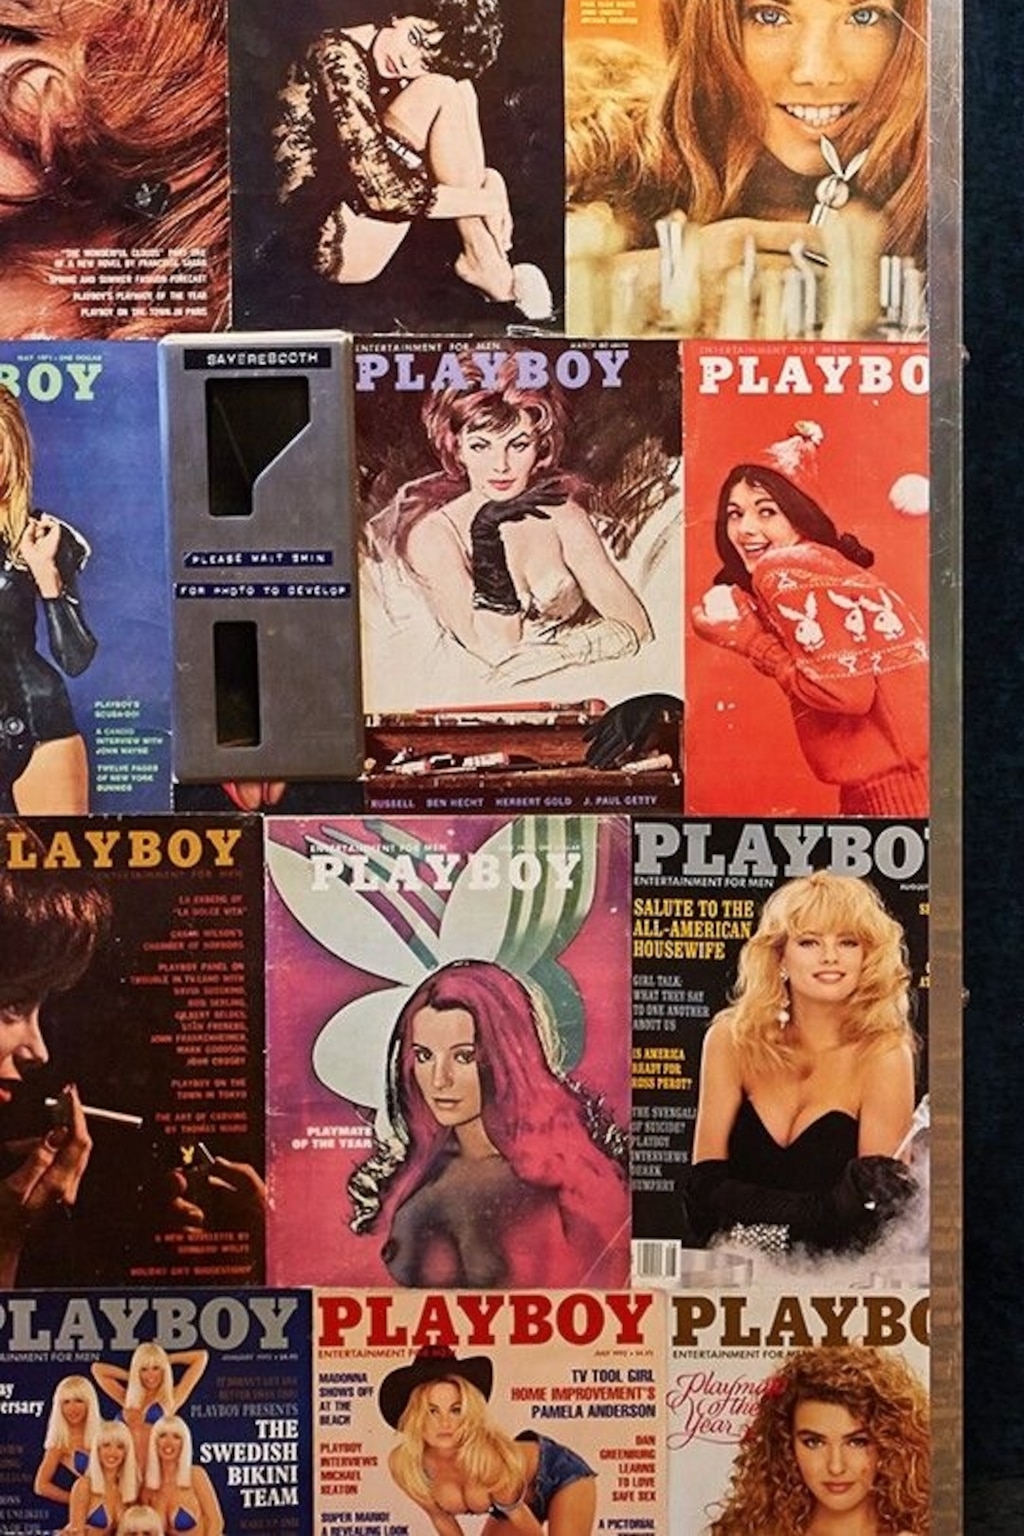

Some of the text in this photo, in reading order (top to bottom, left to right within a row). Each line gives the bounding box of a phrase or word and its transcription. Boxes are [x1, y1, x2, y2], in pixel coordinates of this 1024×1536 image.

[355, 350, 629, 391] PLAYBOY
[699, 355, 929, 395] PLAYBO
[192, 553, 243, 564] PLEASE
[251, 553, 284, 563] WAIT
[180, 585, 346, 596] FOR PHOTO TO DEVELOP
[370, 799, 415, 808] RUSSELL
[426, 799, 447, 807] BEN
[450, 798, 484, 807] HECHT
[496, 797, 541, 806] HERBERT
[543, 797, 573, 806] GOLD
[596, 796, 622, 805] PAUL
[623, 796, 658, 805] GETTY
[7, 829, 242, 869] LAYBOY
[634, 822, 929, 879] PLAYBO
[312, 853, 581, 891] PLAYBOY
[634, 876, 774, 887] ENTERTAINMENT FOR MEN
[634, 899, 754, 919] SALUTE TO THE
[633, 919, 752, 938] ALL-AMERICAN
[633, 940, 726, 959] HOUSEWIFE
[306, 1126, 372, 1136] PLAYMATE
[291, 1139, 373, 1149] OF THE YEAR
[0, 1296, 298, 1351] LAYBOY
[318, 1293, 653, 1347] PLAYBOY
[673, 1350, 783, 1359] ENTERTAINMENT FOR
[319, 1373, 367, 1383] MADONNA
[572, 1369, 655, 1383] TV TOOL GIRL
[319, 1387, 374, 1397] SHOWS OFF
[511, 1386, 656, 1401] HOME IMPROVEMENT'S
[191, 1403, 299, 1418] PLAYBOY PRESENTS
[319, 1401, 351, 1411] AT THE
[532, 1404, 656, 1419] PAMELA ANDERSON
[319, 1415, 351, 1425] BEACH
[668, 1398, 738, 1450] Year
[255, 1419, 299, 1439] THE
[635, 1435, 655, 1445] DAN
[200, 1442, 298, 1464] SWEDISH
[320, 1443, 362, 1453] PLAYBOY
[320, 1457, 378, 1467] INTERVIEWS
[227, 1465, 299, 1486] BIKINI
[320, 1471, 361, 1481] MICHAEL
[618, 1477, 655, 1487] TO LOVE
[320, 1485, 358, 1494] KEATON
[612, 1491, 655, 1501] SAFE SEX
[240, 1487, 299, 1508] TEAM
